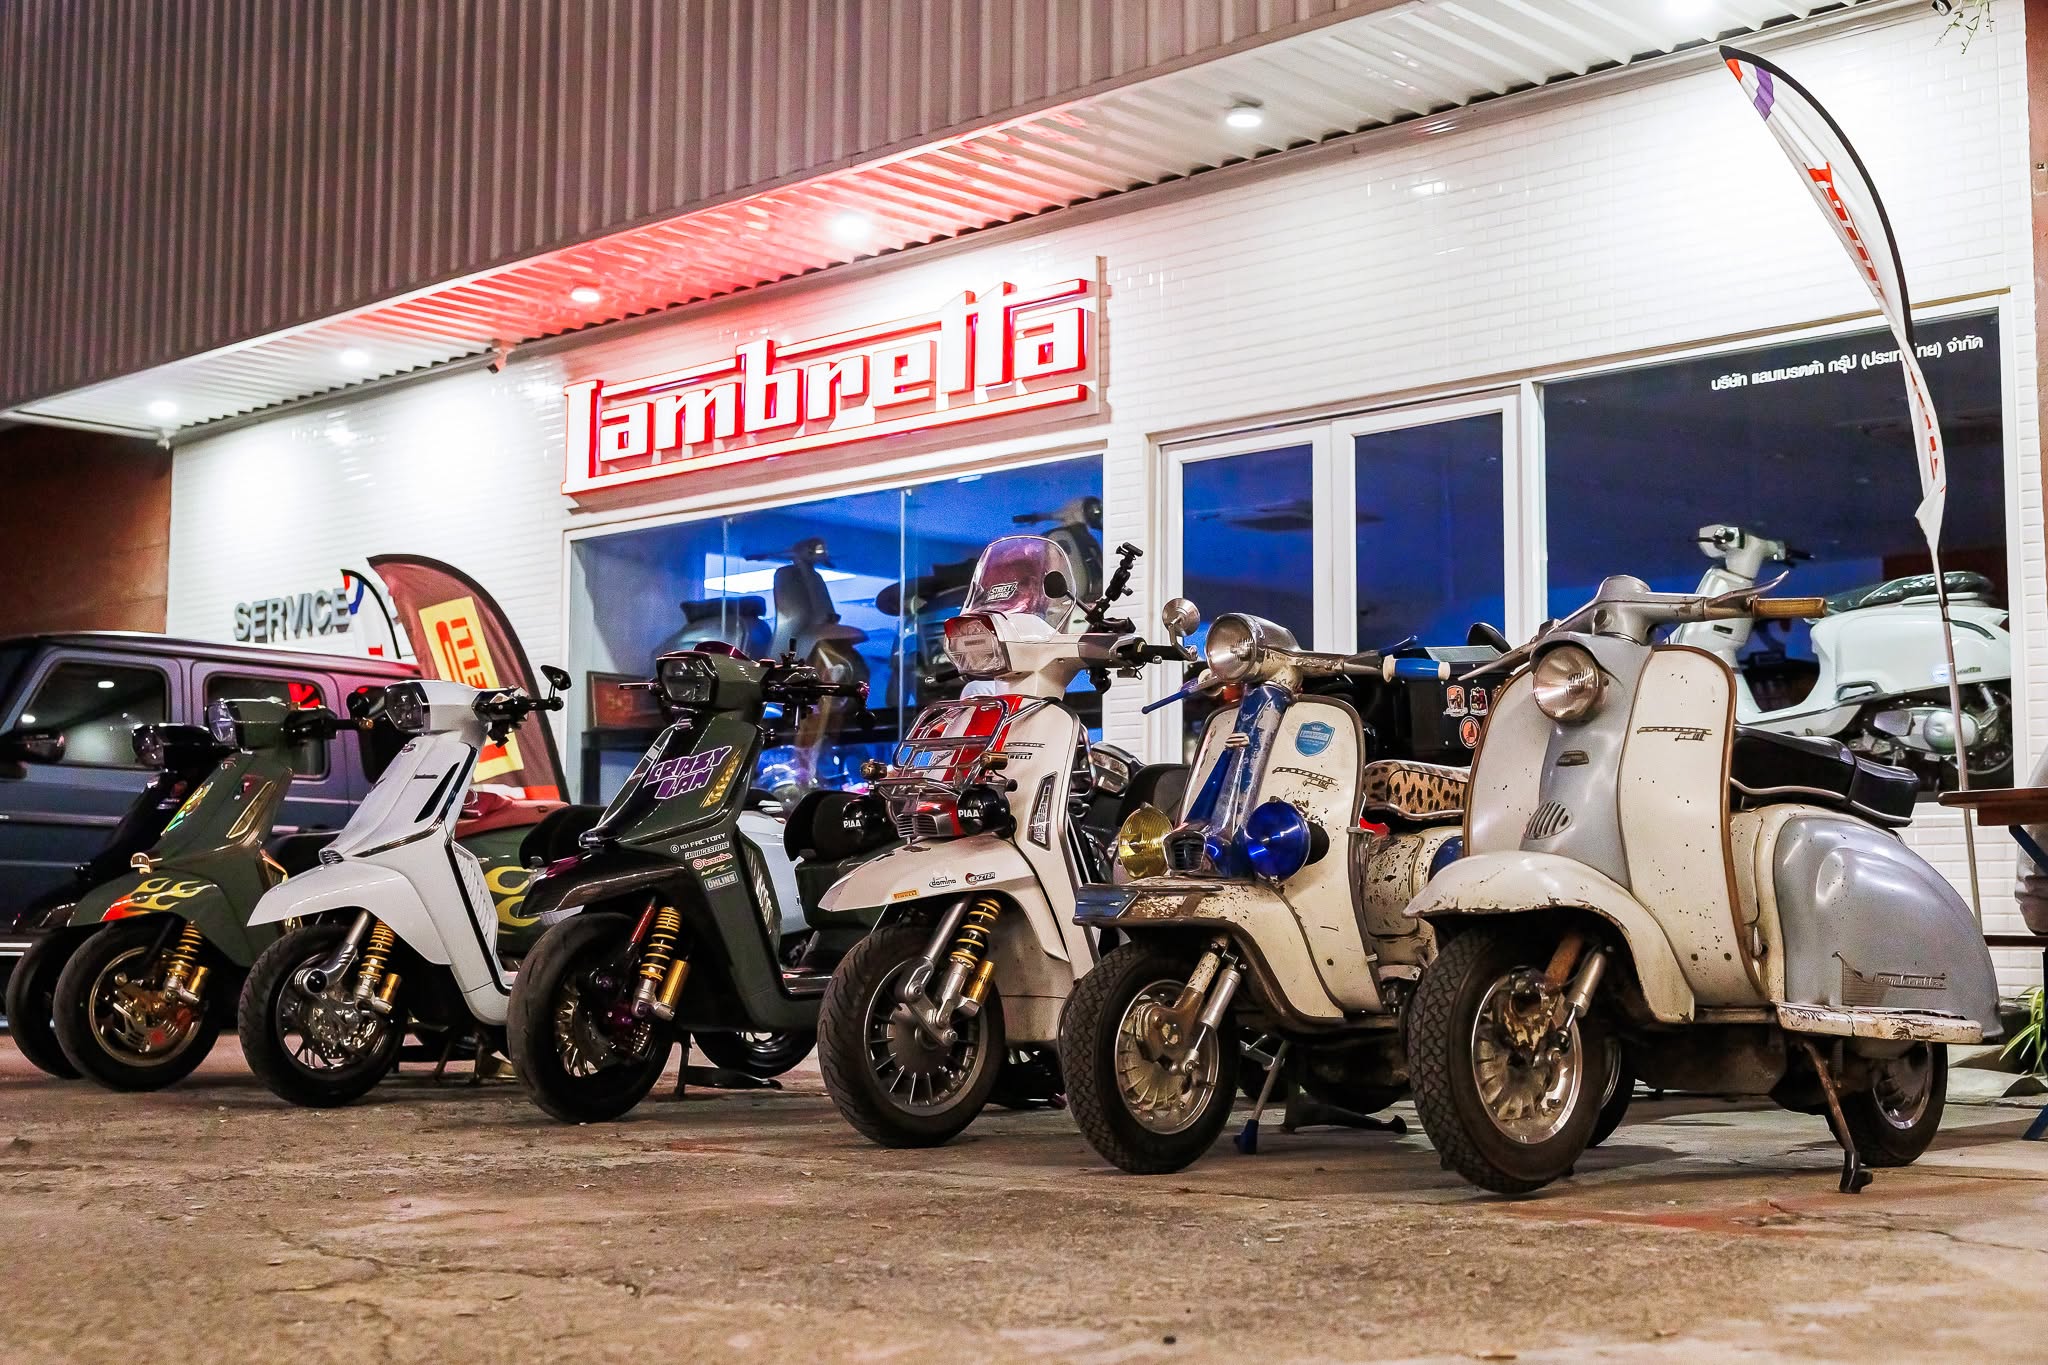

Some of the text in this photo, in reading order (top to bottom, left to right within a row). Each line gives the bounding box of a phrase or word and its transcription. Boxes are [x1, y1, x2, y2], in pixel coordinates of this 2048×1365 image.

[1711, 373, 1748, 390] บริษัท
[1828, 353, 1857, 374] กรุ๊ป
[1861, 342, 1942, 370] (ประเททย)
[1946, 335, 1984, 353] จำกัด
[562, 278, 1088, 495] Lambretta
[233, 588, 351, 643] SERVICE
[643, 746, 733, 788] CRAZY
[654, 767, 714, 799] LAM
[843, 818, 862, 828] PIAA
[958, 809, 980, 818] PIAA
[690, 832, 726, 848] FACTORY
